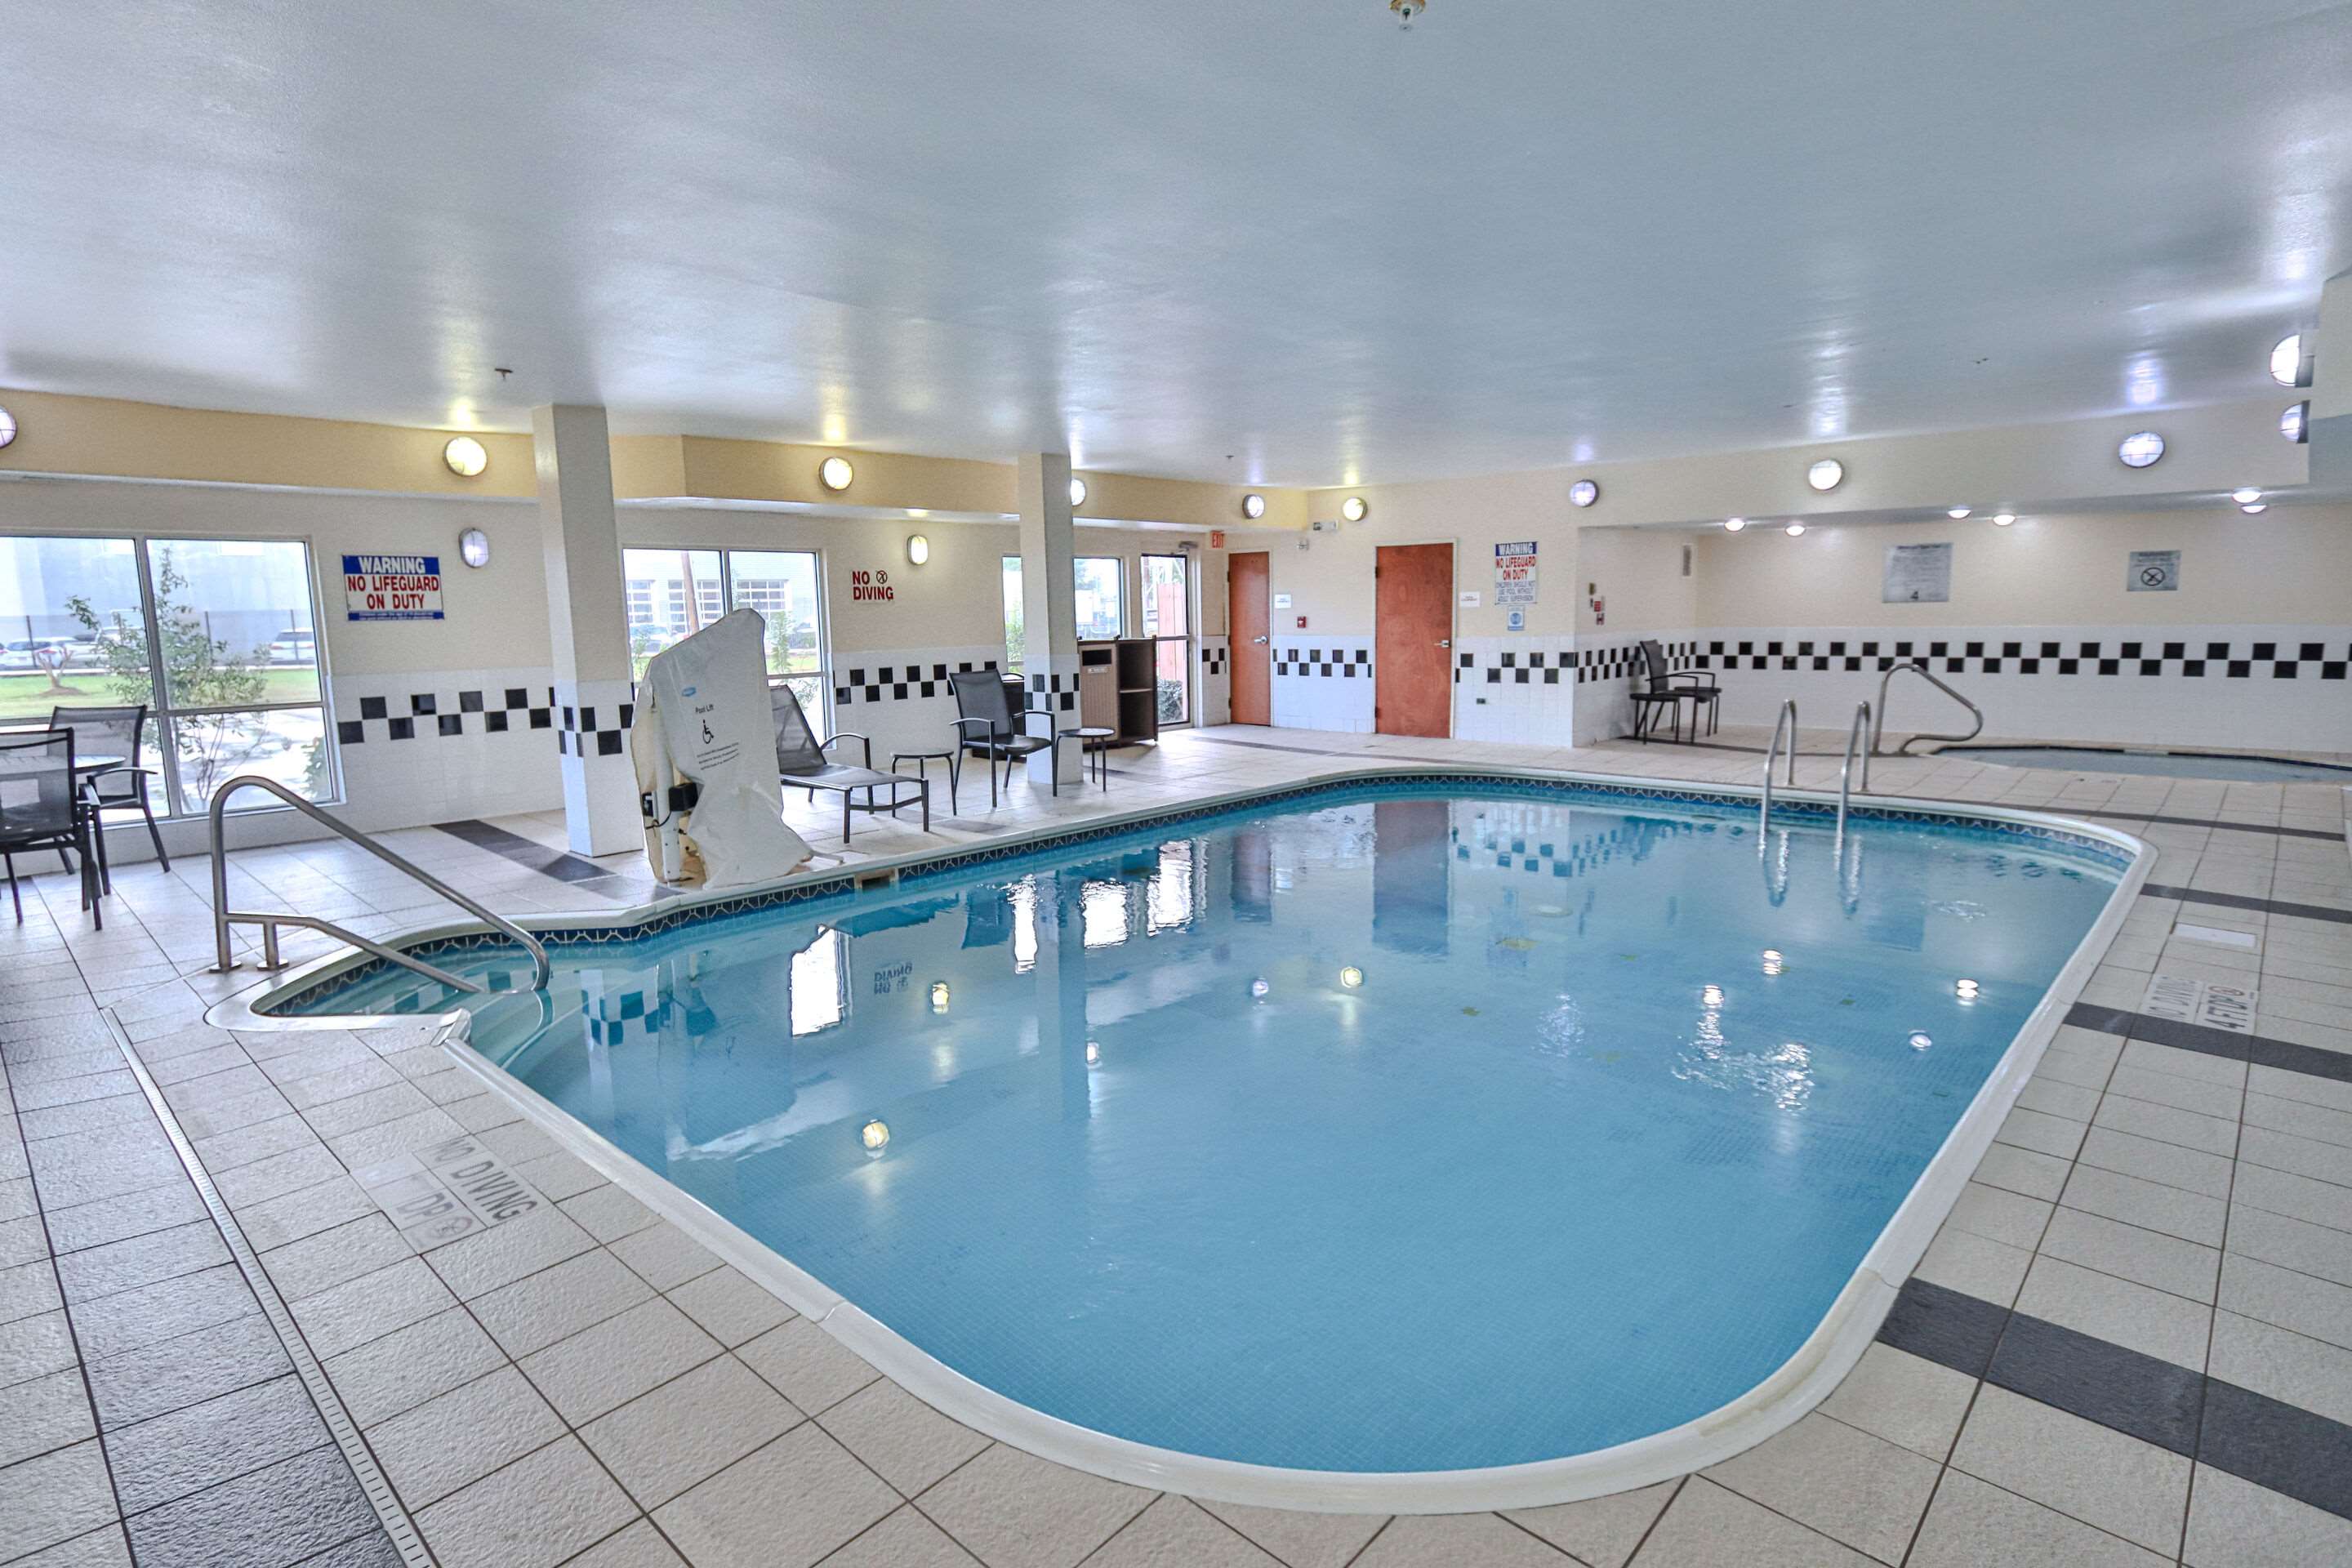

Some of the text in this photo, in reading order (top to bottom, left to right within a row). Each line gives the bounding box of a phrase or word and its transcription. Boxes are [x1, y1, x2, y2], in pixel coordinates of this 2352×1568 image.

[1499, 542, 1534, 555] WARNING
[358, 556, 425, 573] WARNING
[1495, 555, 1535, 568] NO LIFEGUARD
[853, 571, 870, 585] NO
[1503, 568, 1528, 581] ON DUTY
[347, 576, 439, 591] NO LIFEGUARD
[853, 586, 893, 600] DIVING
[367, 594, 425, 609] ON DUTY
[2204, 995, 2248, 1029] 4 FT DP
[426, 1138, 537, 1221] NO DIVING
[396, 1192, 454, 1220] DP
